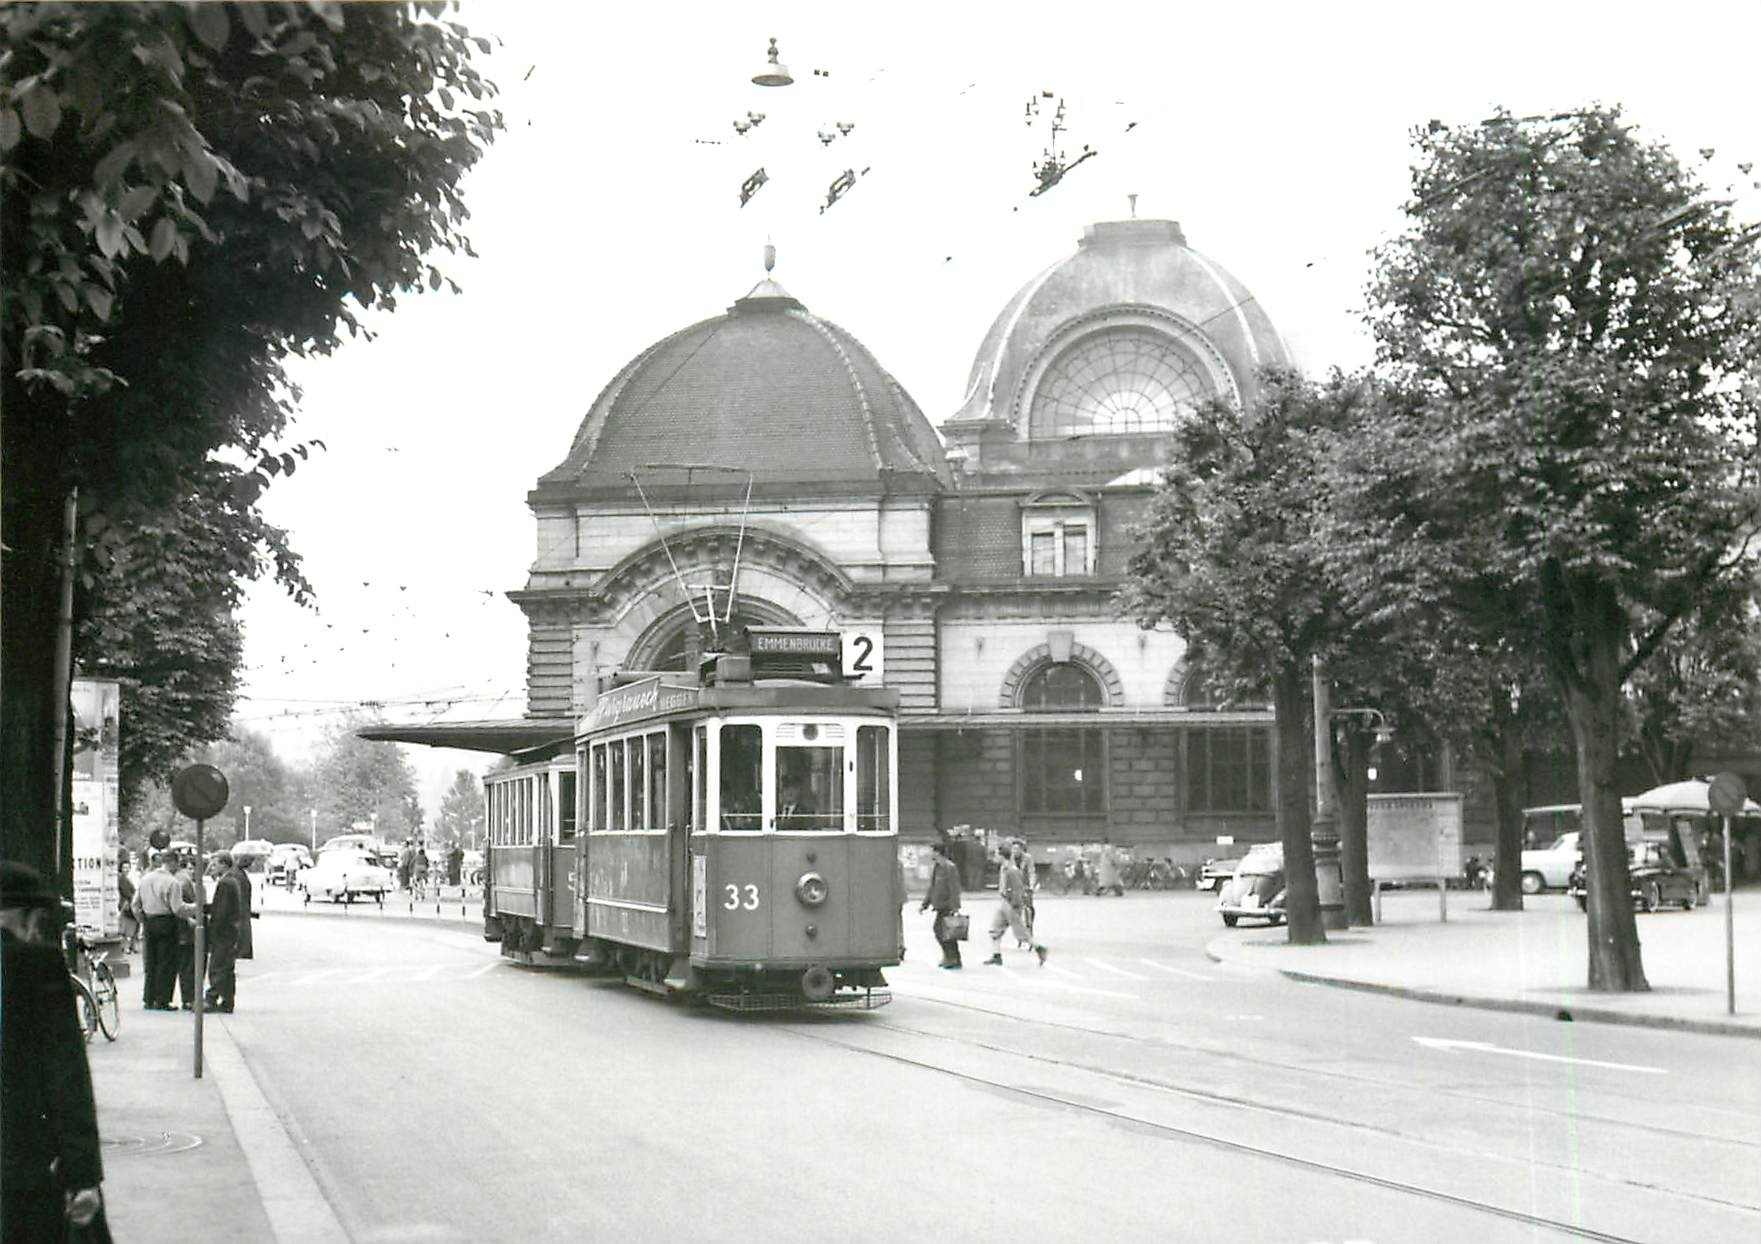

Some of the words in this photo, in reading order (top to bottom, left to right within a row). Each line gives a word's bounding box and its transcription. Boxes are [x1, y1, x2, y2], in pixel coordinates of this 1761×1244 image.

[853, 636, 873, 671] 2
[72, 857, 101, 870] TION
[724, 884, 759, 910] 33
